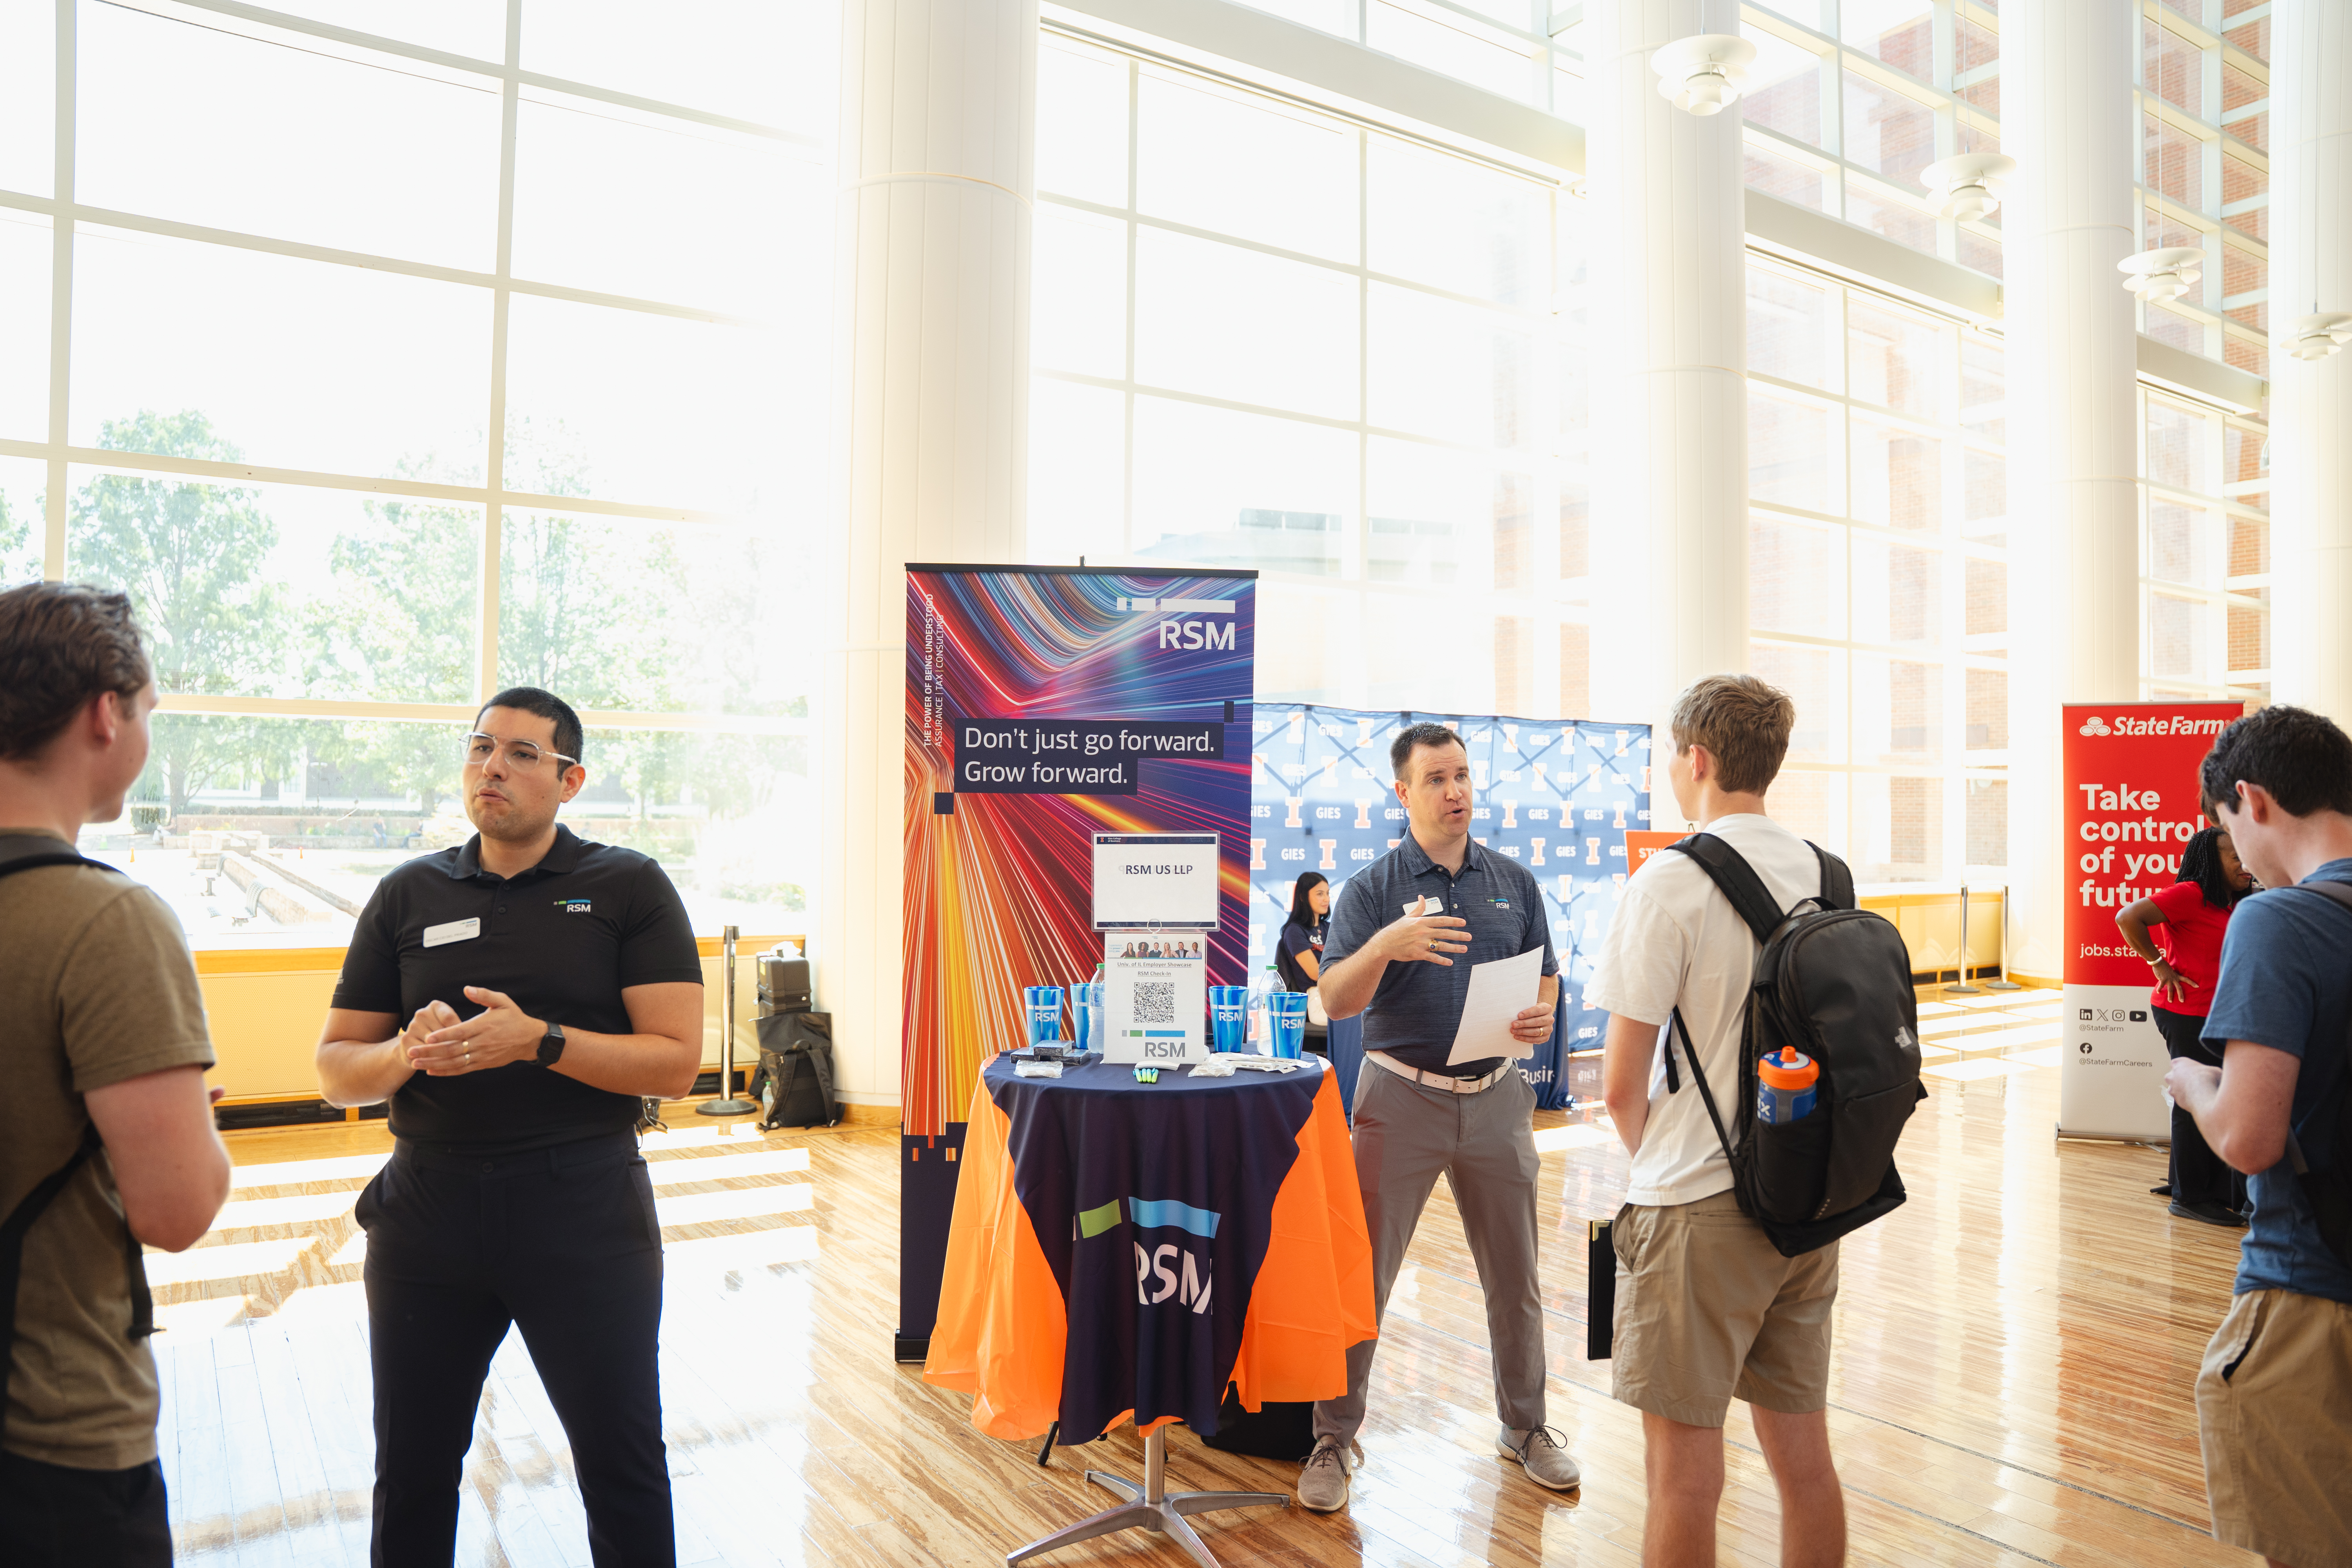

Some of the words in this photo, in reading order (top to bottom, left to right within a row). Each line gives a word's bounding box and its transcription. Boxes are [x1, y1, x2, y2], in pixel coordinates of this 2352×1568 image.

[1160, 621, 1235, 650] RSM
[925, 683, 932, 694] OF
[965, 728, 1028, 749] Don't
[1032, 731, 1078, 754] just
[1085, 735, 1113, 755] go
[1119, 732, 1214, 752] forward.
[1252, 720, 1273, 733] IES
[1318, 724, 1343, 737] GIES
[1471, 731, 1492, 742] GIES
[1529, 734, 1550, 746] GIES
[1586, 735, 1605, 748] GIES
[1638, 738, 1651, 749] GIE
[965, 761, 1025, 782] Grow
[1032, 762, 1127, 783] forward.
[2080, 784, 2160, 811] Take
[1316, 807, 1341, 819] GIES
[1528, 809, 1549, 820] GIES
[1584, 809, 1604, 821] GIES
[2080, 815, 2204, 842] control
[1281, 848, 1305, 860] GIES
[1350, 848, 1374, 860] GIES
[1556, 846, 1576, 857] GIES
[1125, 865, 1151, 874] RSM
[1156, 865, 1171, 874] US
[1174, 865, 1193, 874] LLP
[2080, 846, 2115, 874] of
[2124, 853, 2183, 880] you
[2079, 879, 2161, 907] futu
[567, 904, 591, 913] RSM
[1035, 1012, 1059, 1022] RSM
[1219, 1012, 1243, 1021] RSM
[1282, 1018, 1305, 1029] RSM
[1578, 1027, 1598, 1039] GIES
[1145, 1042, 1185, 1058] RSM
[2079, 1058, 2152, 1067] @StateFarmCareers
[1134, 1241, 1212, 1315] RSM
